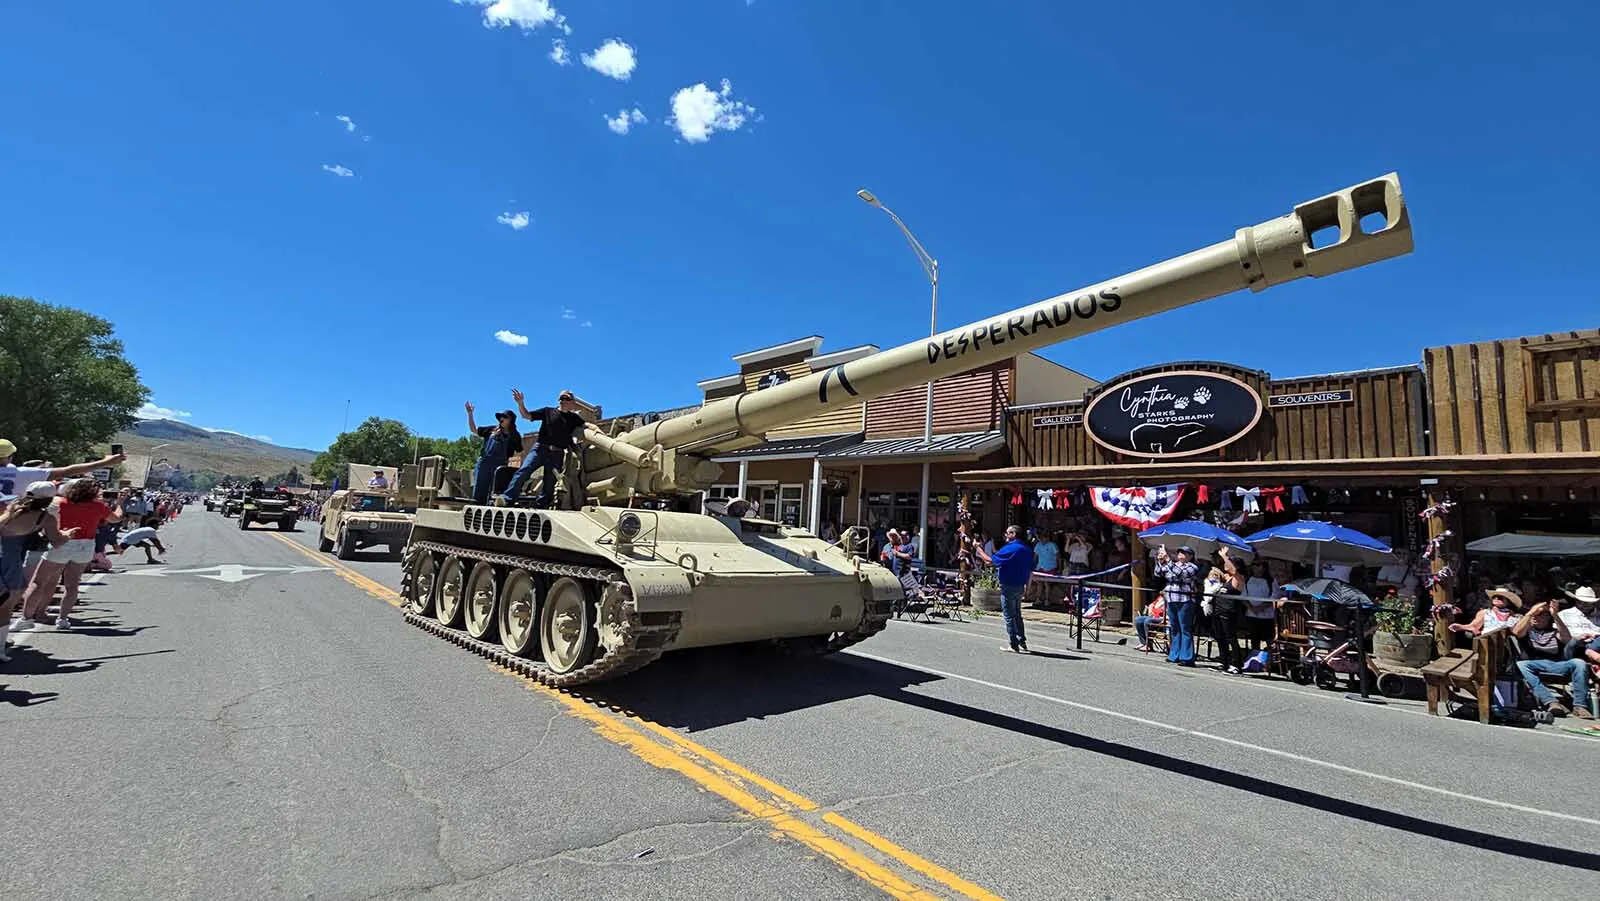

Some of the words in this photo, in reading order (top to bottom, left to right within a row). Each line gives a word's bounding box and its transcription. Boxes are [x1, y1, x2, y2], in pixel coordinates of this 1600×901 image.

[927, 286, 1122, 364] DESPERADOS
[1120, 384, 1176, 418] Cynthia
[1277, 392, 1342, 405] SOUVENIRS
[1137, 409, 1176, 419] STARKS
[1146, 413, 1215, 423] PHOTOGRAPHY
[1040, 416, 1075, 424] GALLERY
